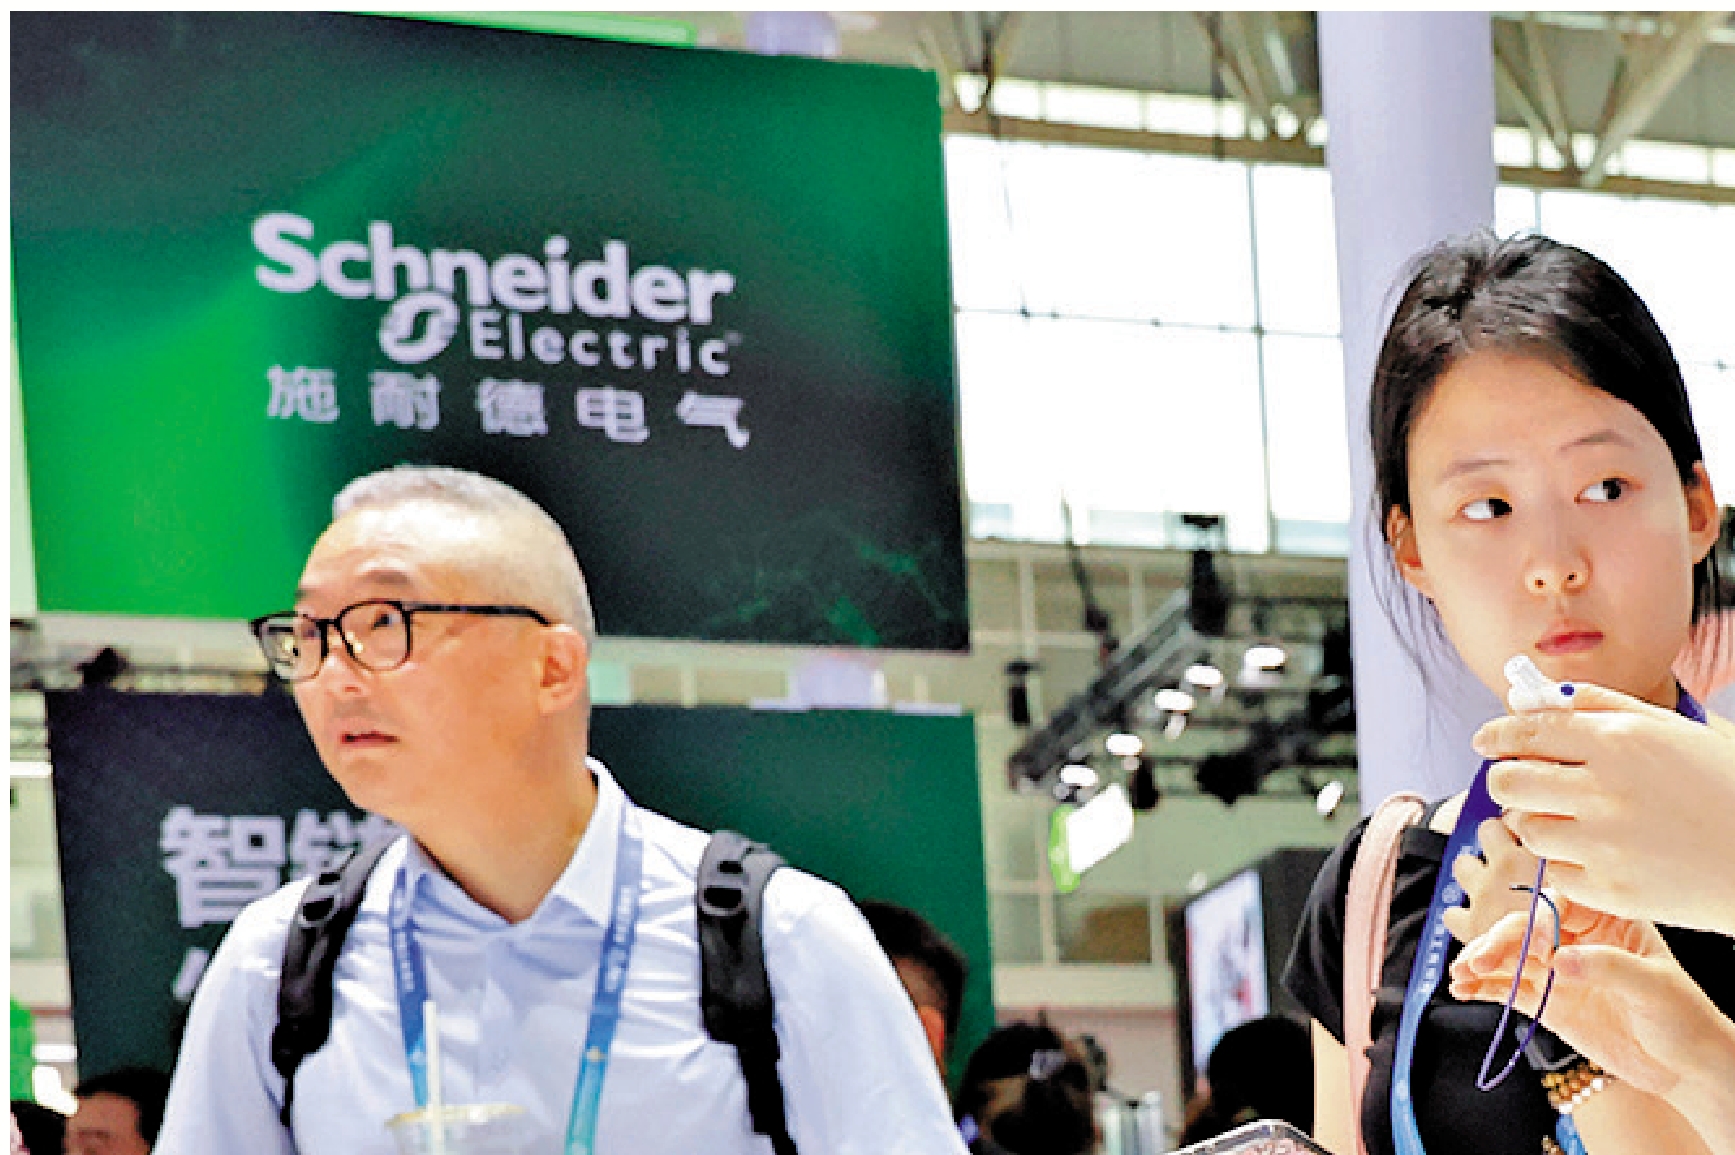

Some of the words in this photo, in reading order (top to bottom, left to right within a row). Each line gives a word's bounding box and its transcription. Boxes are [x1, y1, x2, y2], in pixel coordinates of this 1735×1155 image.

[251, 212, 735, 325] Schneider
[469, 308, 731, 376] Electric
[266, 364, 750, 449] 施耐德电气
